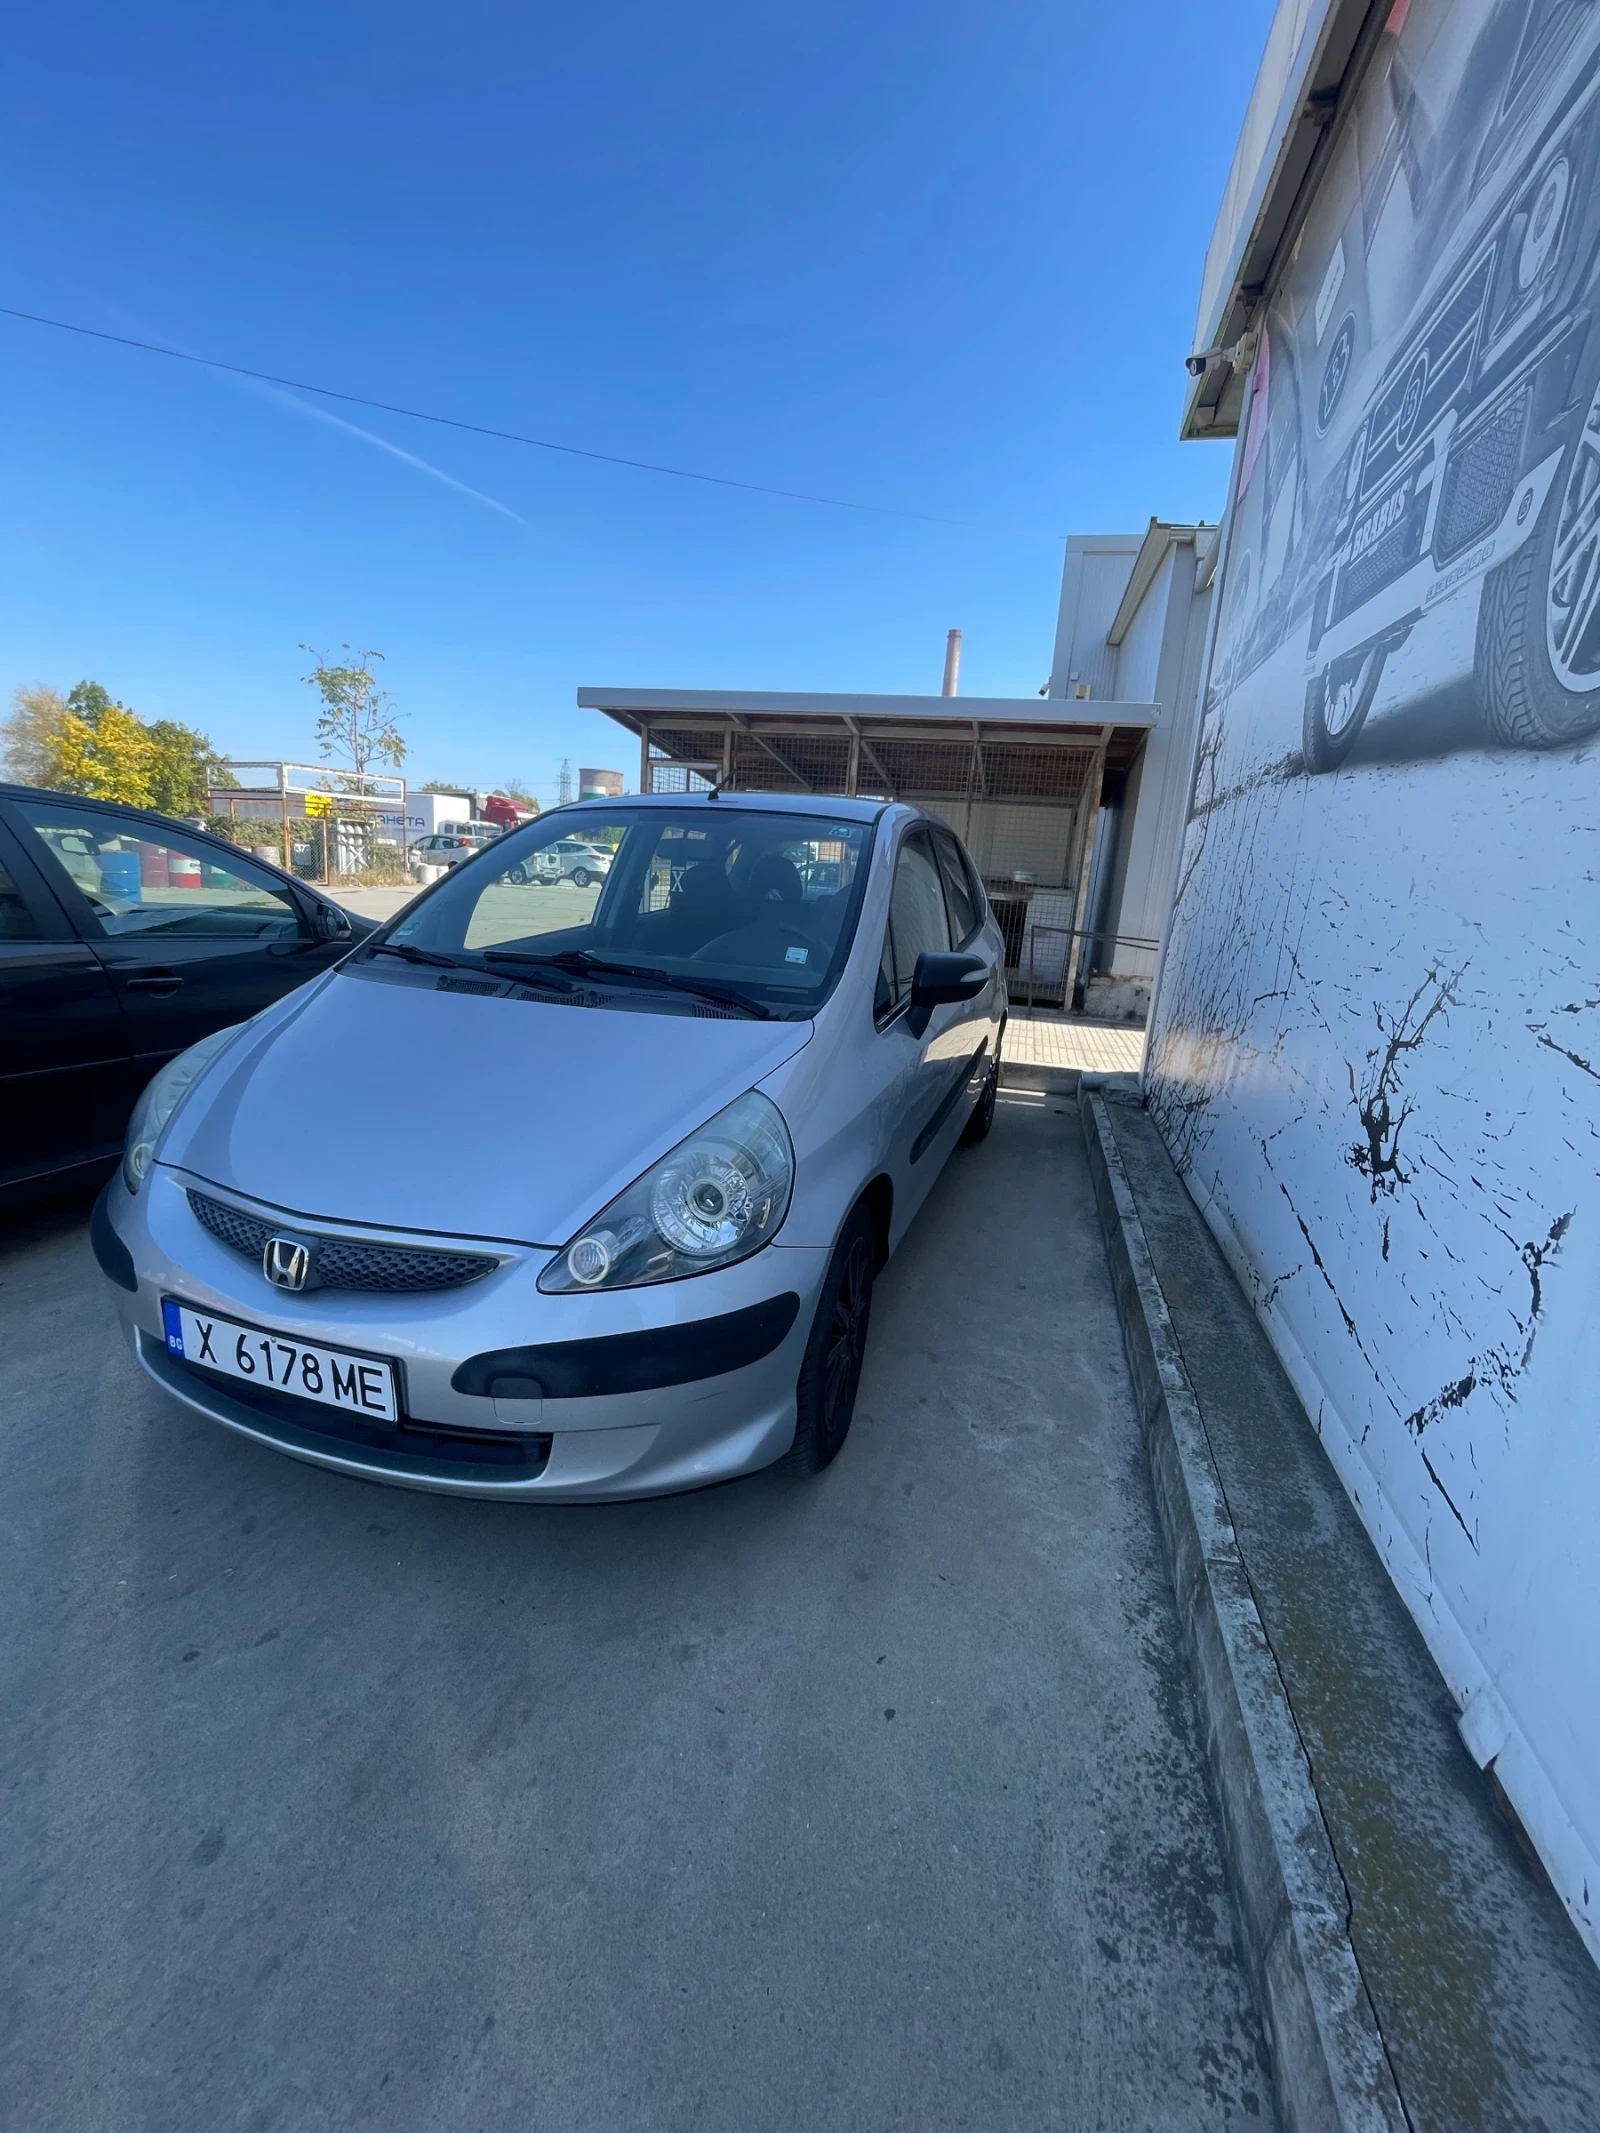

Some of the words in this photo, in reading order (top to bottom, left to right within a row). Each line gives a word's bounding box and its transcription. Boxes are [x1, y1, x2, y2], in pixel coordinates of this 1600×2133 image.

[1351, 474, 1412, 561] BRABUS
[169, 1335, 183, 1351] BG
[195, 1318, 219, 1364] X
[236, 1333, 324, 1394] 6178
[330, 1358, 387, 1413] ME
